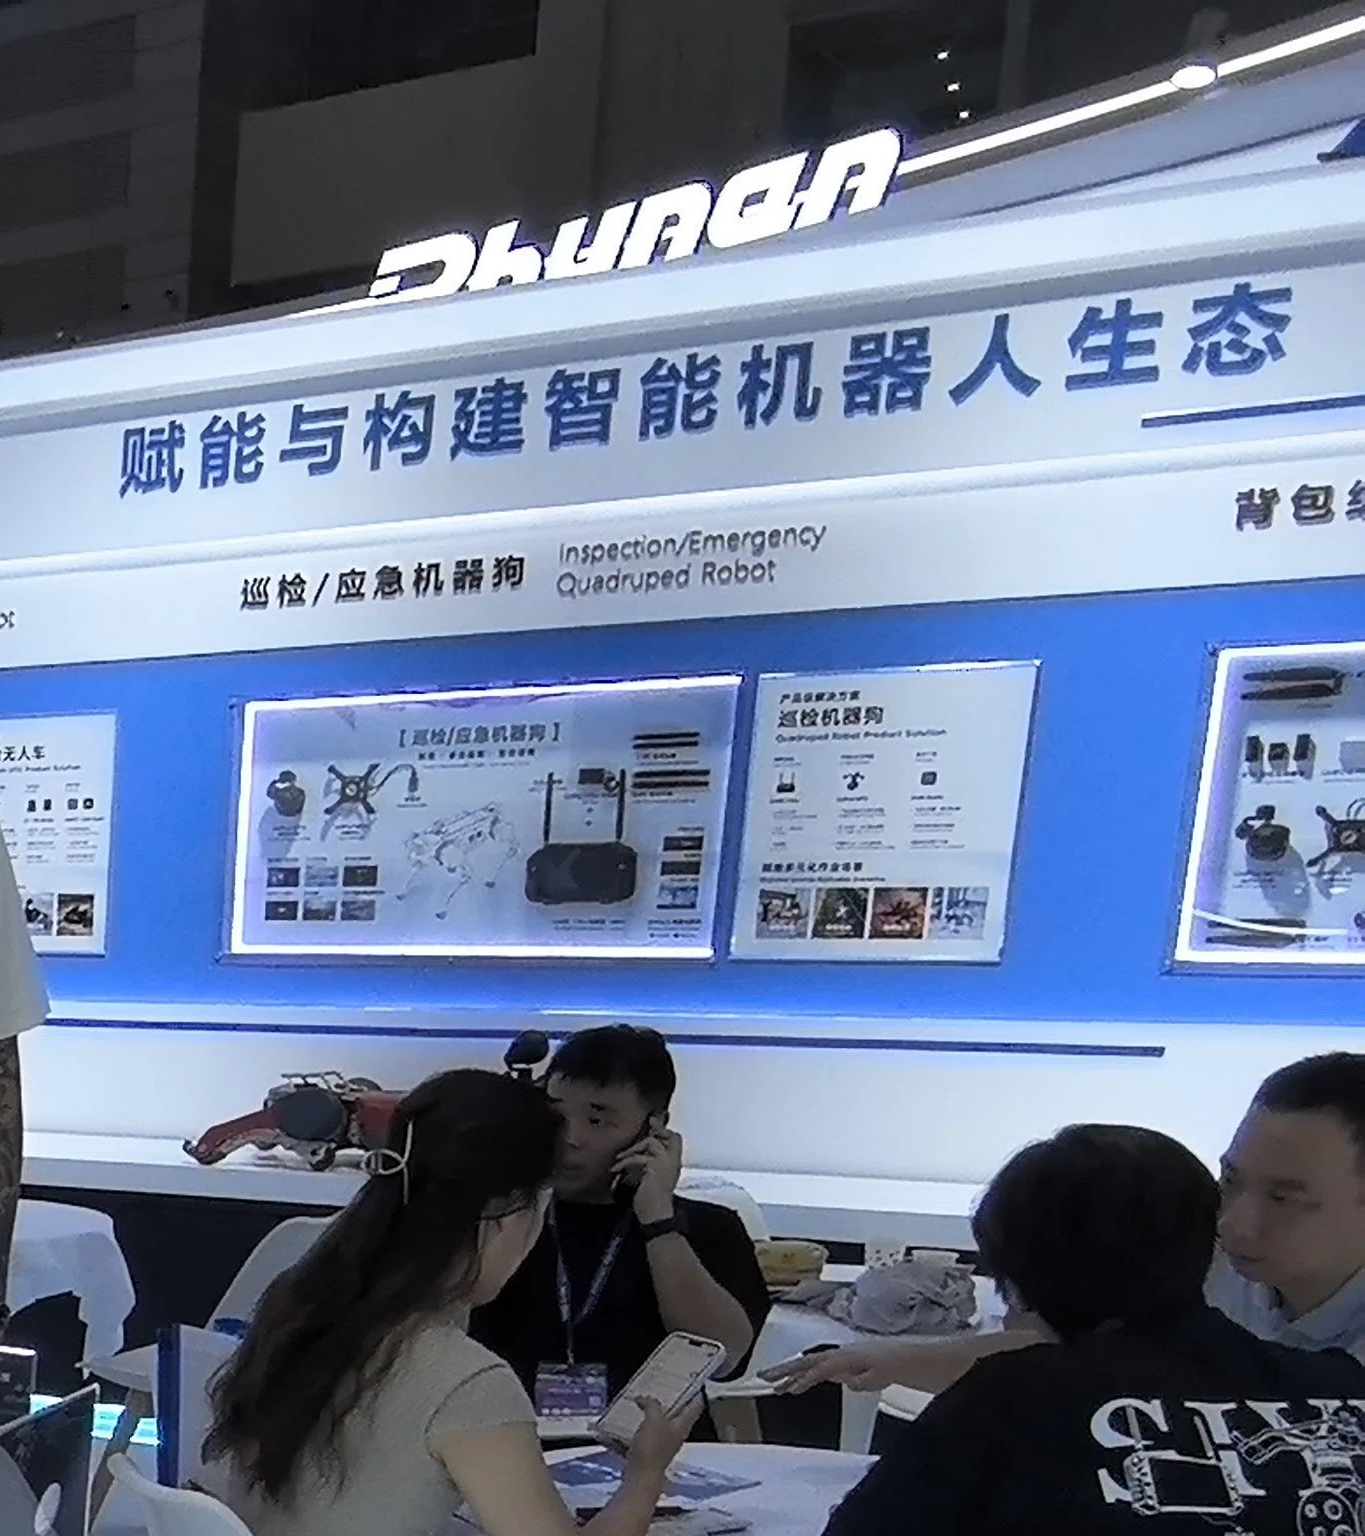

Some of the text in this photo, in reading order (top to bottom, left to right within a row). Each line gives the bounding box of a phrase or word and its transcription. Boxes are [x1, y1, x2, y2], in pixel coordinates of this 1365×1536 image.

[119, 282, 1293, 499] 赋能与构建智能机器人生态
[558, 523, 828, 566] Inspection/Emergency
[240, 554, 527, 612] 巡检/应急机器狗
[556, 558, 777, 599] Quadruped Robot
[776, 705, 885, 729] 巡检机器狗
